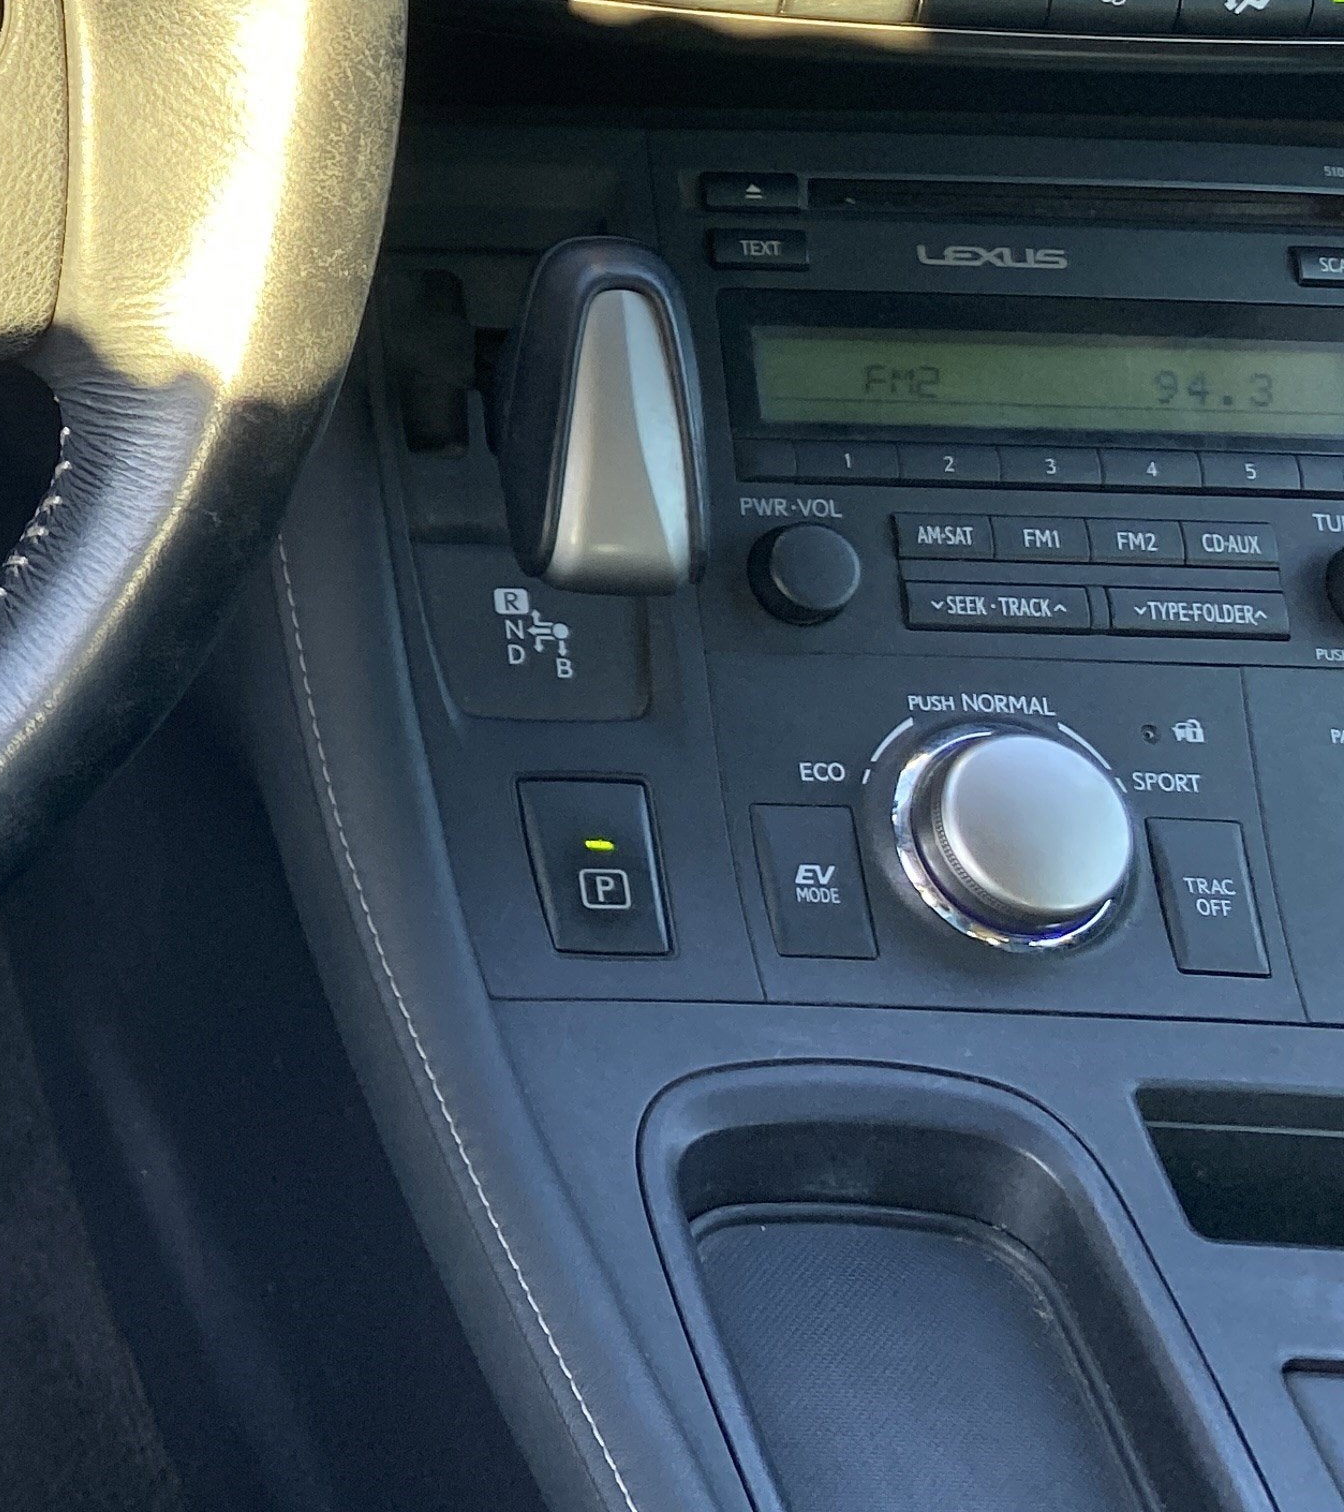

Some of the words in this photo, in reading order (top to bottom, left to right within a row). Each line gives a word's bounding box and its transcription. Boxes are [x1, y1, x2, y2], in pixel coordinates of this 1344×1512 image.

[739, 239, 781, 257] TEXT
[917, 244, 1068, 269] LEXUS
[863, 363, 941, 399] FM2
[1153, 369, 1275, 408] 94.3
[844, 453, 852, 469] 1
[945, 456, 955, 473] 2
[1046, 458, 1057, 475] 3
[1146, 460, 1158, 477] 4
[1245, 463, 1256, 480] 5
[1312, 512, 1344, 532] TU
[1023, 529, 1060, 548] FM1
[1117, 532, 1158, 551] FM2
[504, 592, 519, 610] R
[947, 595, 987, 616] SEEK
[998, 597, 1052, 618] TRACK
[505, 620, 524, 639] N
[507, 644, 525, 664] D
[556, 658, 573, 678] B
[908, 695, 955, 711] PUSH
[961, 693, 1056, 716] NORMAL
[800, 763, 845, 782] ECO
[1132, 772, 1201, 794] SPORT
[795, 865, 835, 885] EV
[595, 877, 614, 902] P
[796, 887, 841, 904] MODE
[1183, 876, 1237, 896] TRAC
[1196, 898, 1232, 918] OFF
